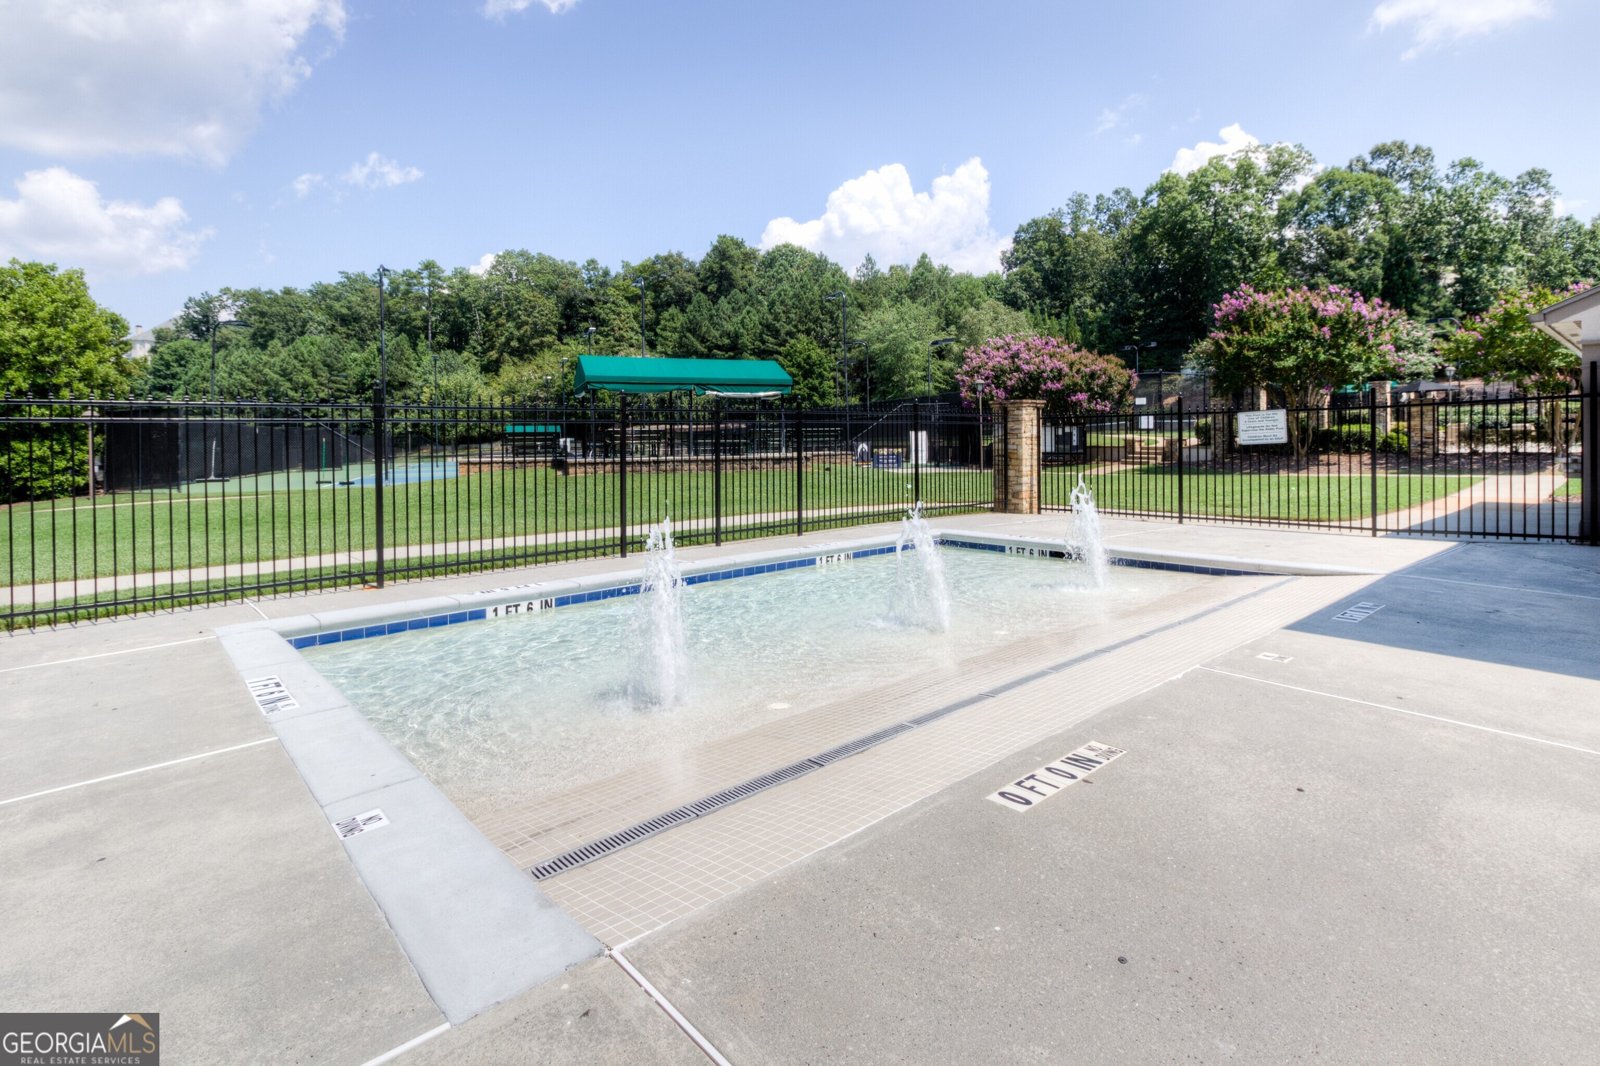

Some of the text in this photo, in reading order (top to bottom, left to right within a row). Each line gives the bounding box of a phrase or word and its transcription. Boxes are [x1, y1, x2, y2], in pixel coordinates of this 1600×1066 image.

[820, 556, 823, 564] 1
[826, 554, 834, 564] FT
[844, 552, 851, 560] IN
[1008, 546, 1012, 554] 1
[1016, 546, 1026, 555] FT
[1038, 549, 1047, 557] IN
[492, 598, 553, 616] 1 FT 6 IN
[1014, 774, 1060, 796] FT
[1060, 754, 1104, 771] IN
